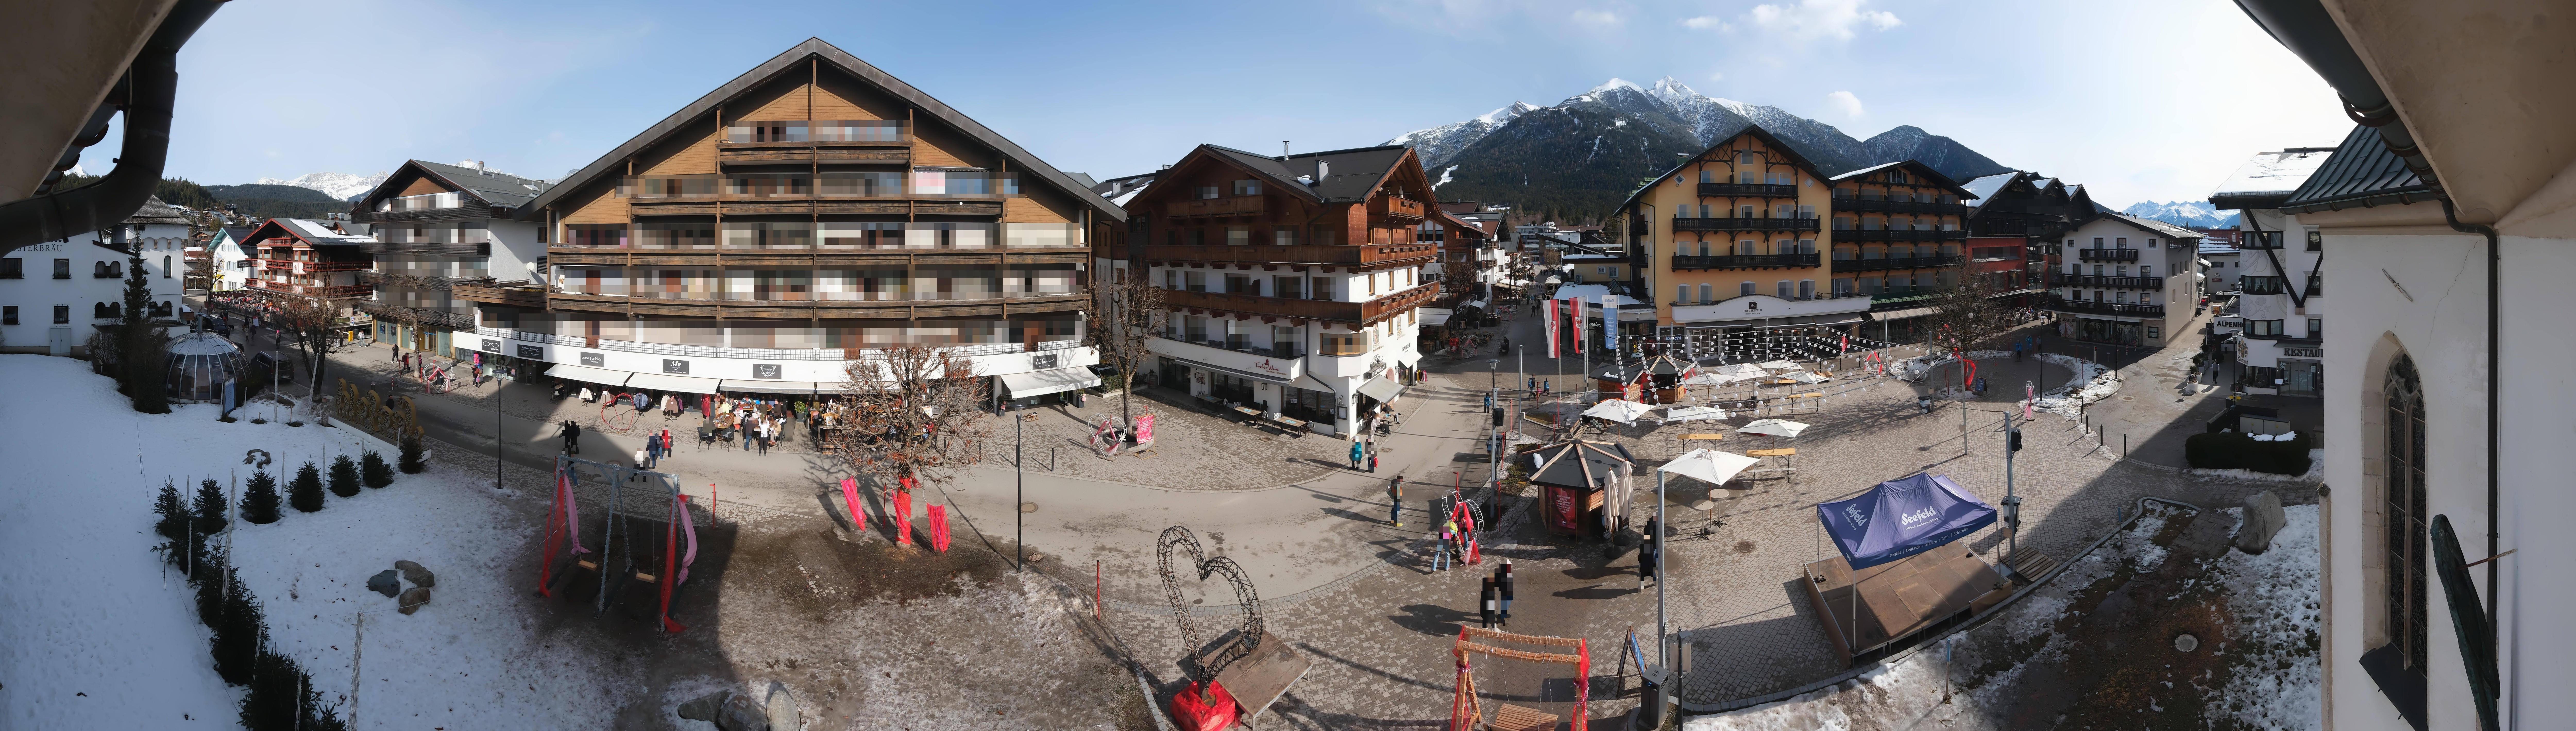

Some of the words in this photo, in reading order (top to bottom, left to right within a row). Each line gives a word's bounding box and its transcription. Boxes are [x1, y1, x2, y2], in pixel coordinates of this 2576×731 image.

[1402, 343, 1411, 351] SAILER
[2237, 355, 2248, 364] Kaltschmid
[1371, 364, 1386, 377] RESTAURANT
[1846, 503, 1868, 526] Seefeld
[1901, 505, 1936, 525] Seefeld
[1846, 516, 1857, 530] HOCHPLATEAU
[1917, 517, 1938, 527] HOCHPLATEAU
